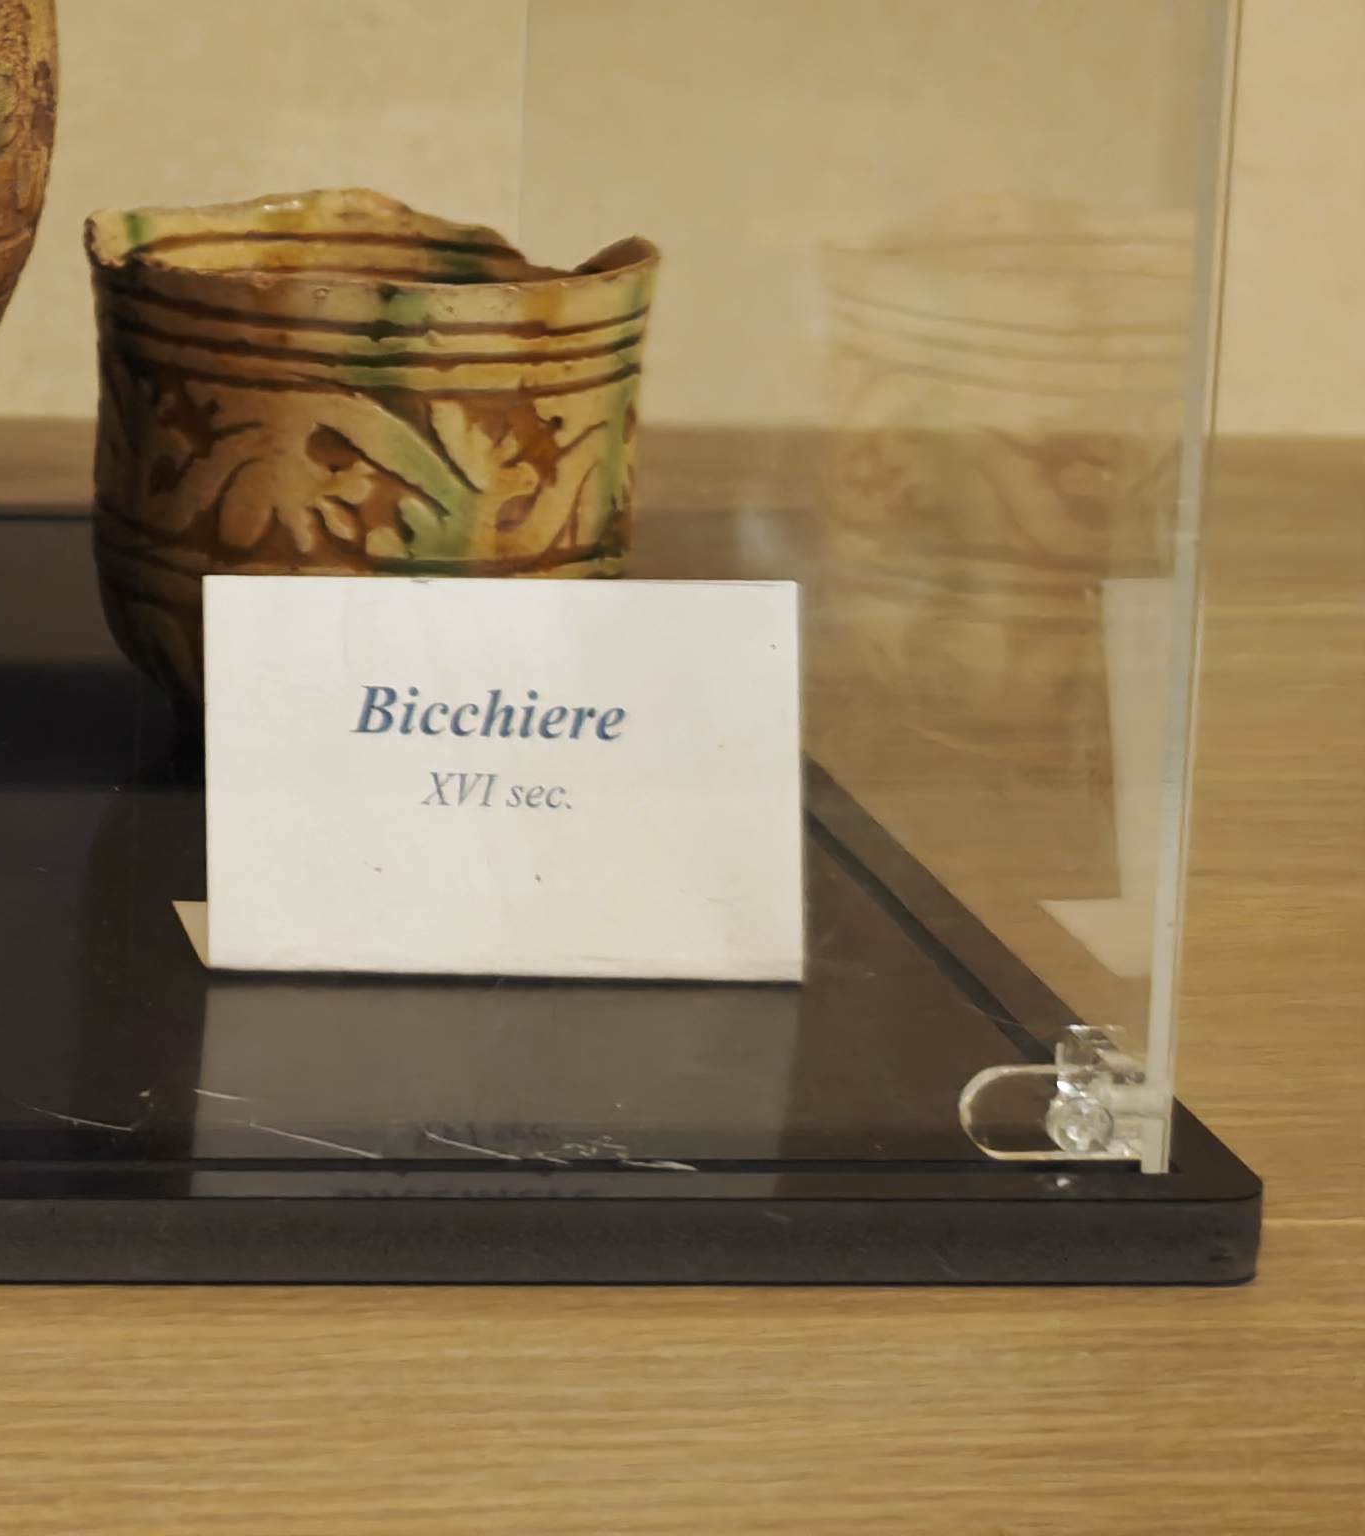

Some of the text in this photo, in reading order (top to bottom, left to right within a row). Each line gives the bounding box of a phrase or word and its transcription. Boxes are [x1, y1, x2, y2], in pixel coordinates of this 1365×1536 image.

[350, 683, 628, 743] Bicchiere
[422, 770, 573, 811] XVI sec.
